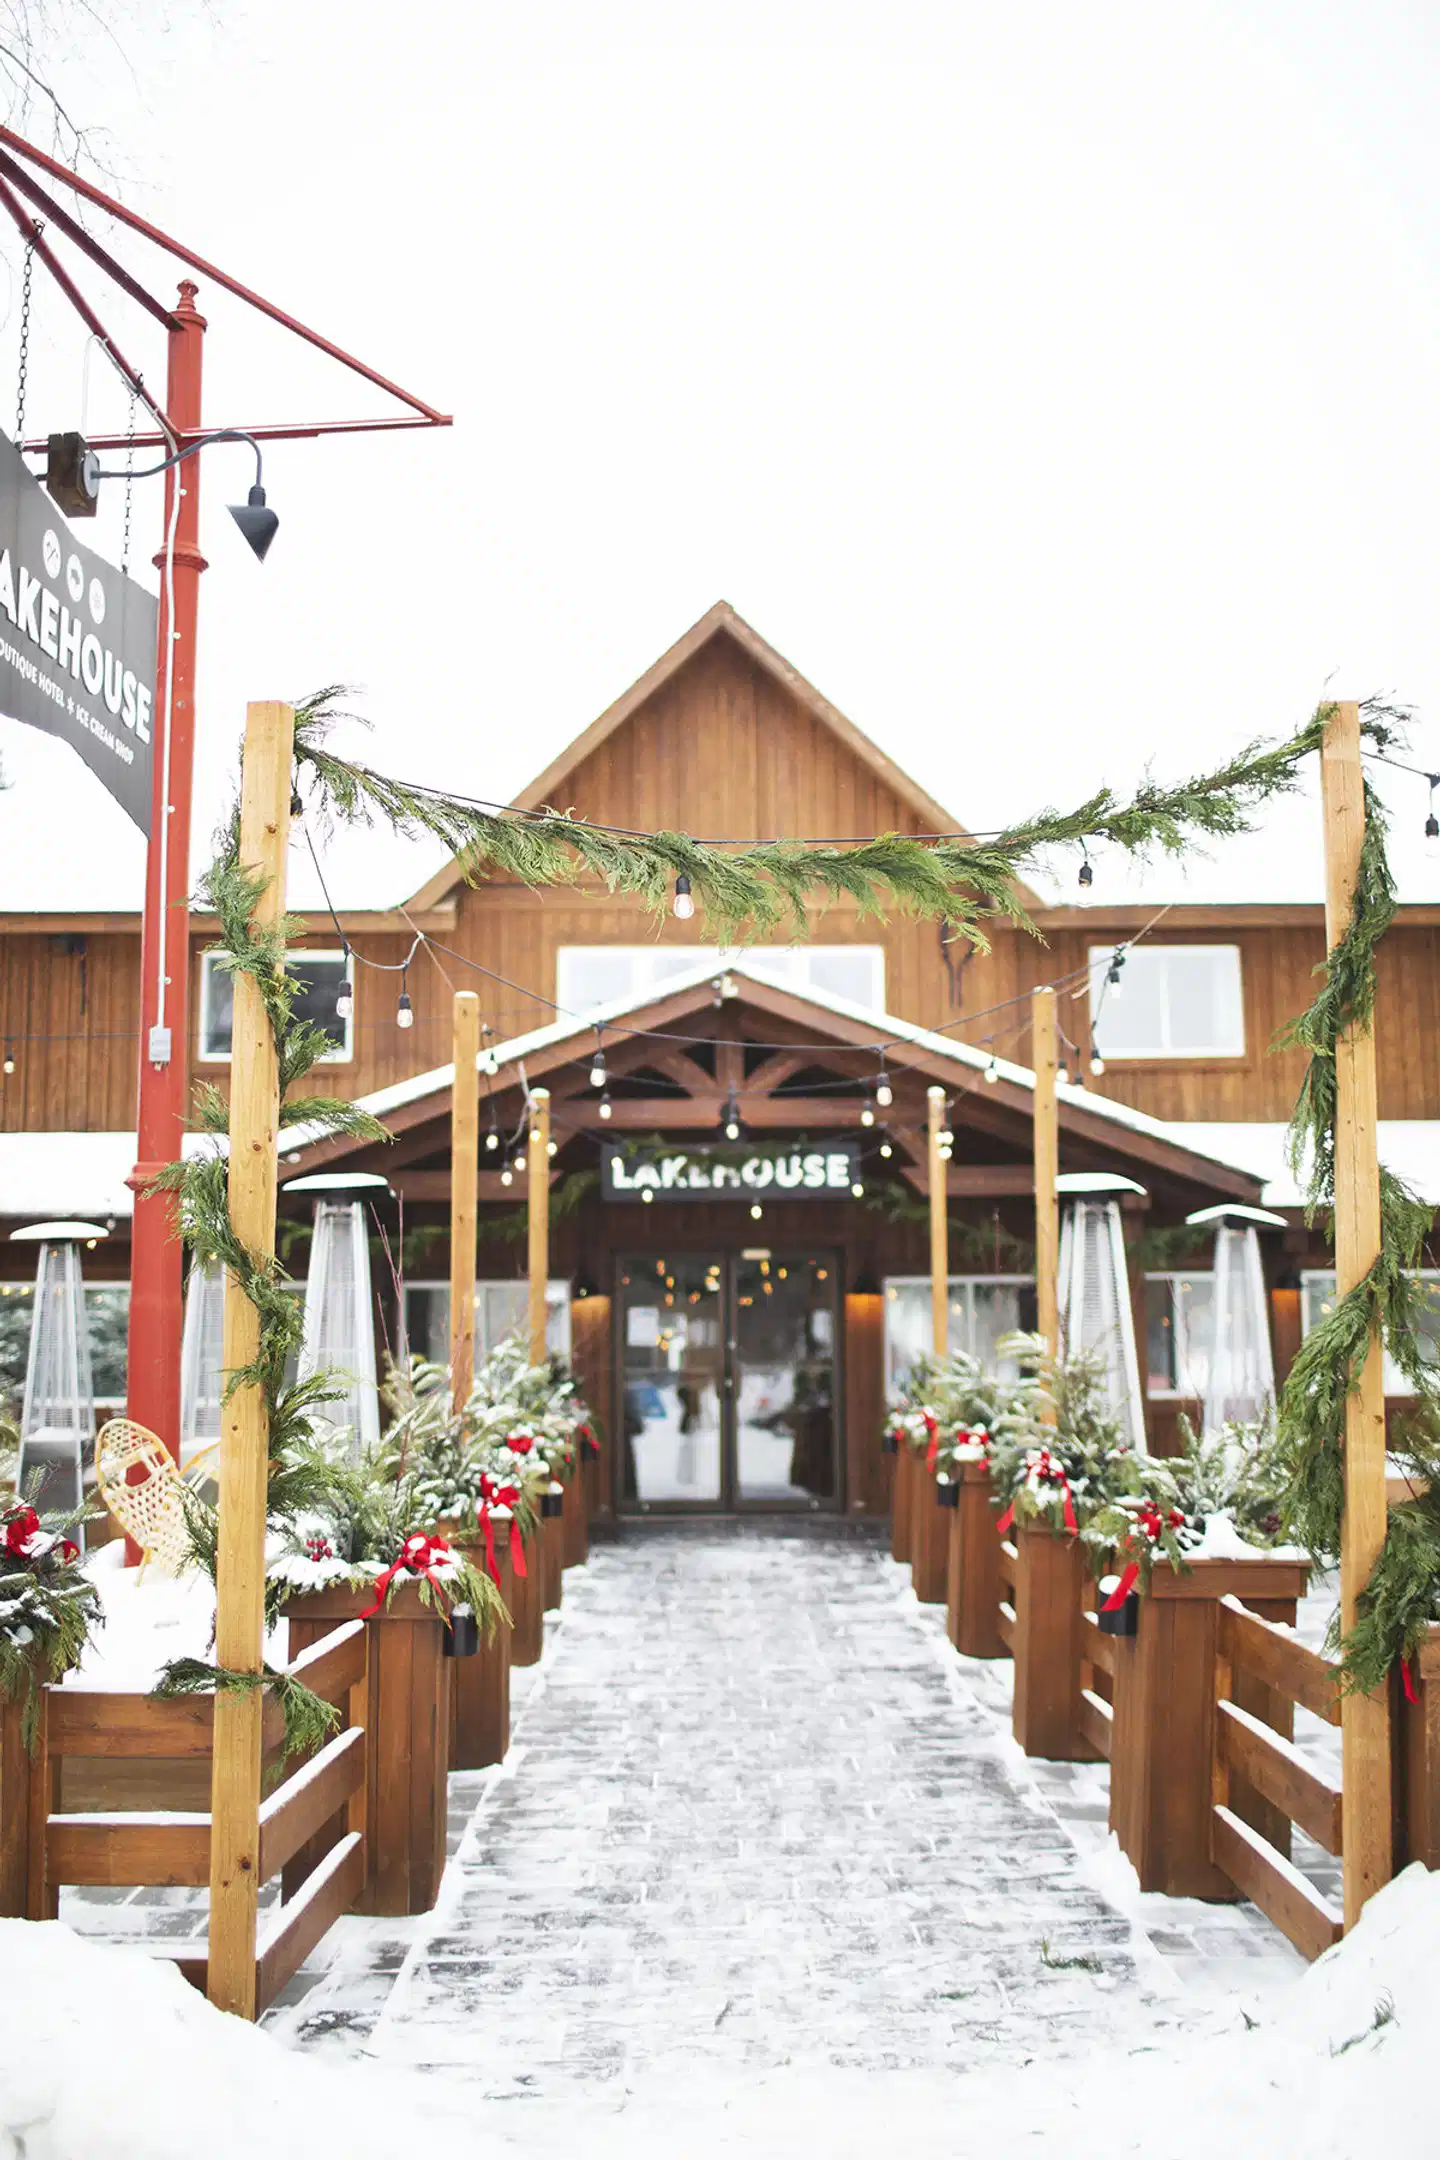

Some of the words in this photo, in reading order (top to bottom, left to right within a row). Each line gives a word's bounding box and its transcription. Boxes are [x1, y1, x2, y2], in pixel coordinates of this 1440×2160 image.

[38, 672, 65, 707] HOTEL
[76, 704, 90, 729] ICE
[89, 717, 115, 751] CREAM
